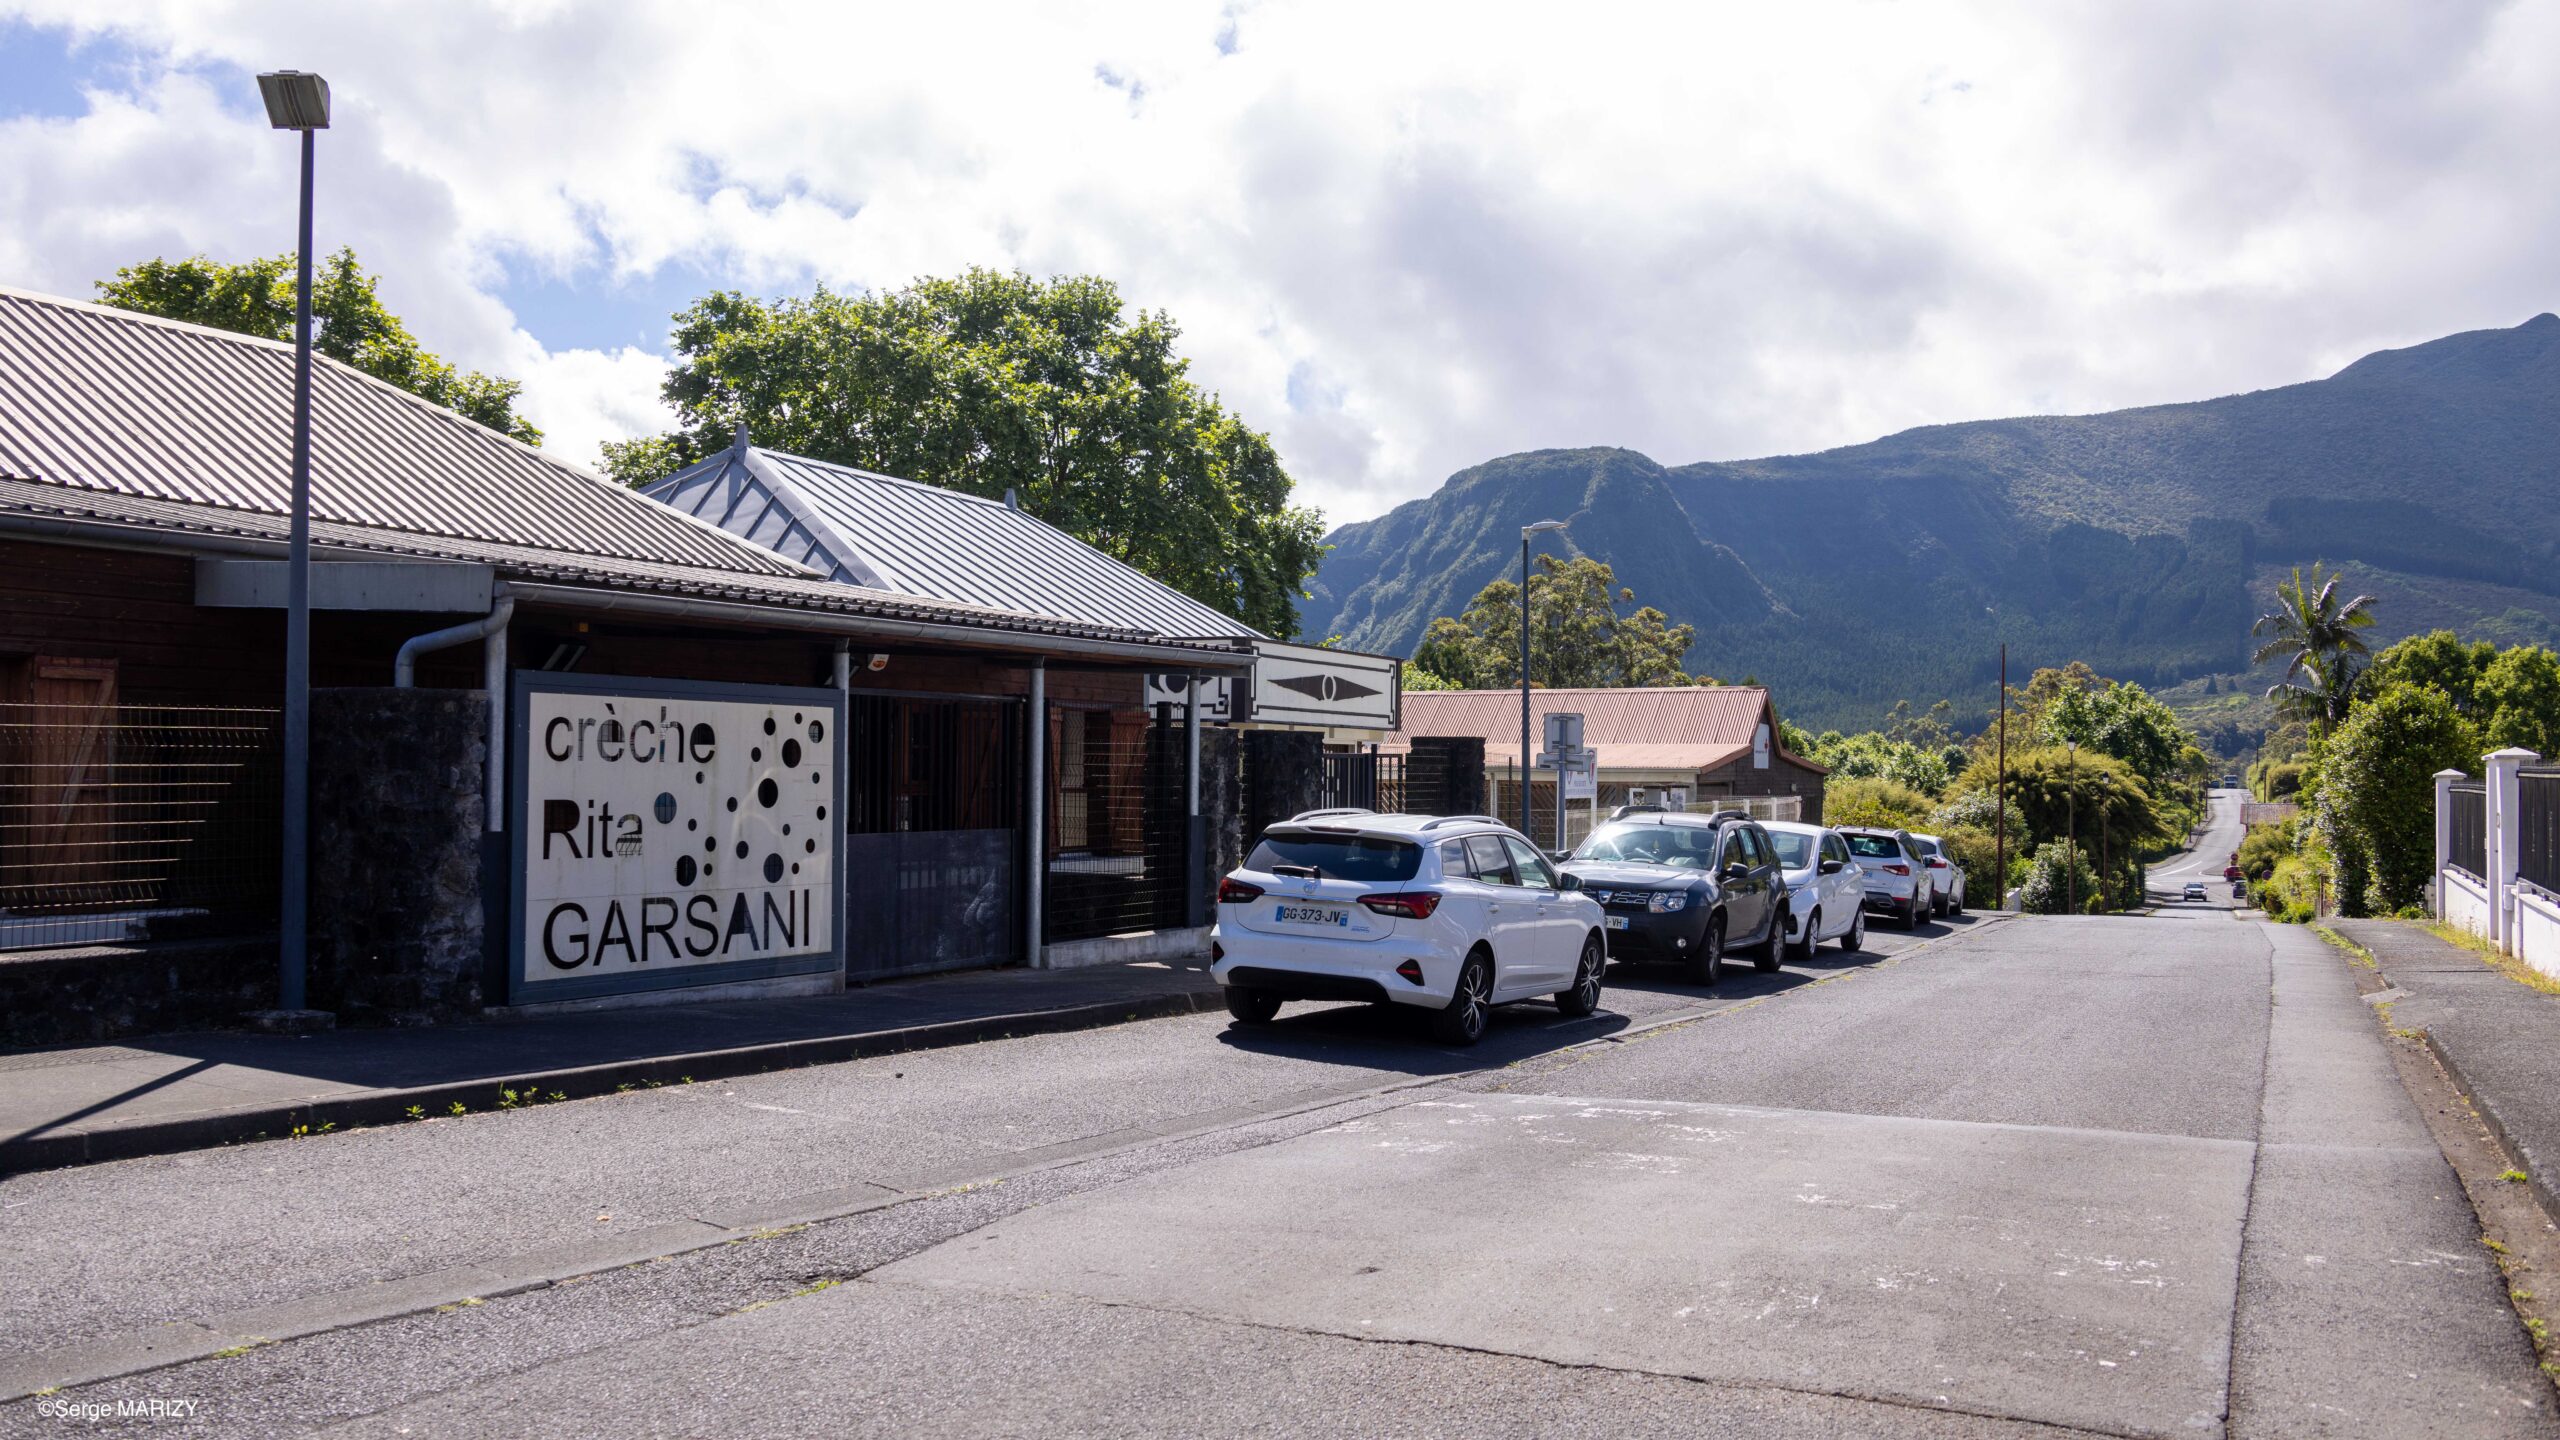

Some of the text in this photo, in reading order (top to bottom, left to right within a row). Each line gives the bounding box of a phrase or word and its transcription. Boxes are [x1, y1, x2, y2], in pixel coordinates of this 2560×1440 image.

[545, 702, 716, 763] crèche
[542, 799, 643, 859] Rita
[542, 888, 810, 970] GARSANI
[1283, 907, 1340, 923] GG-373-JV
